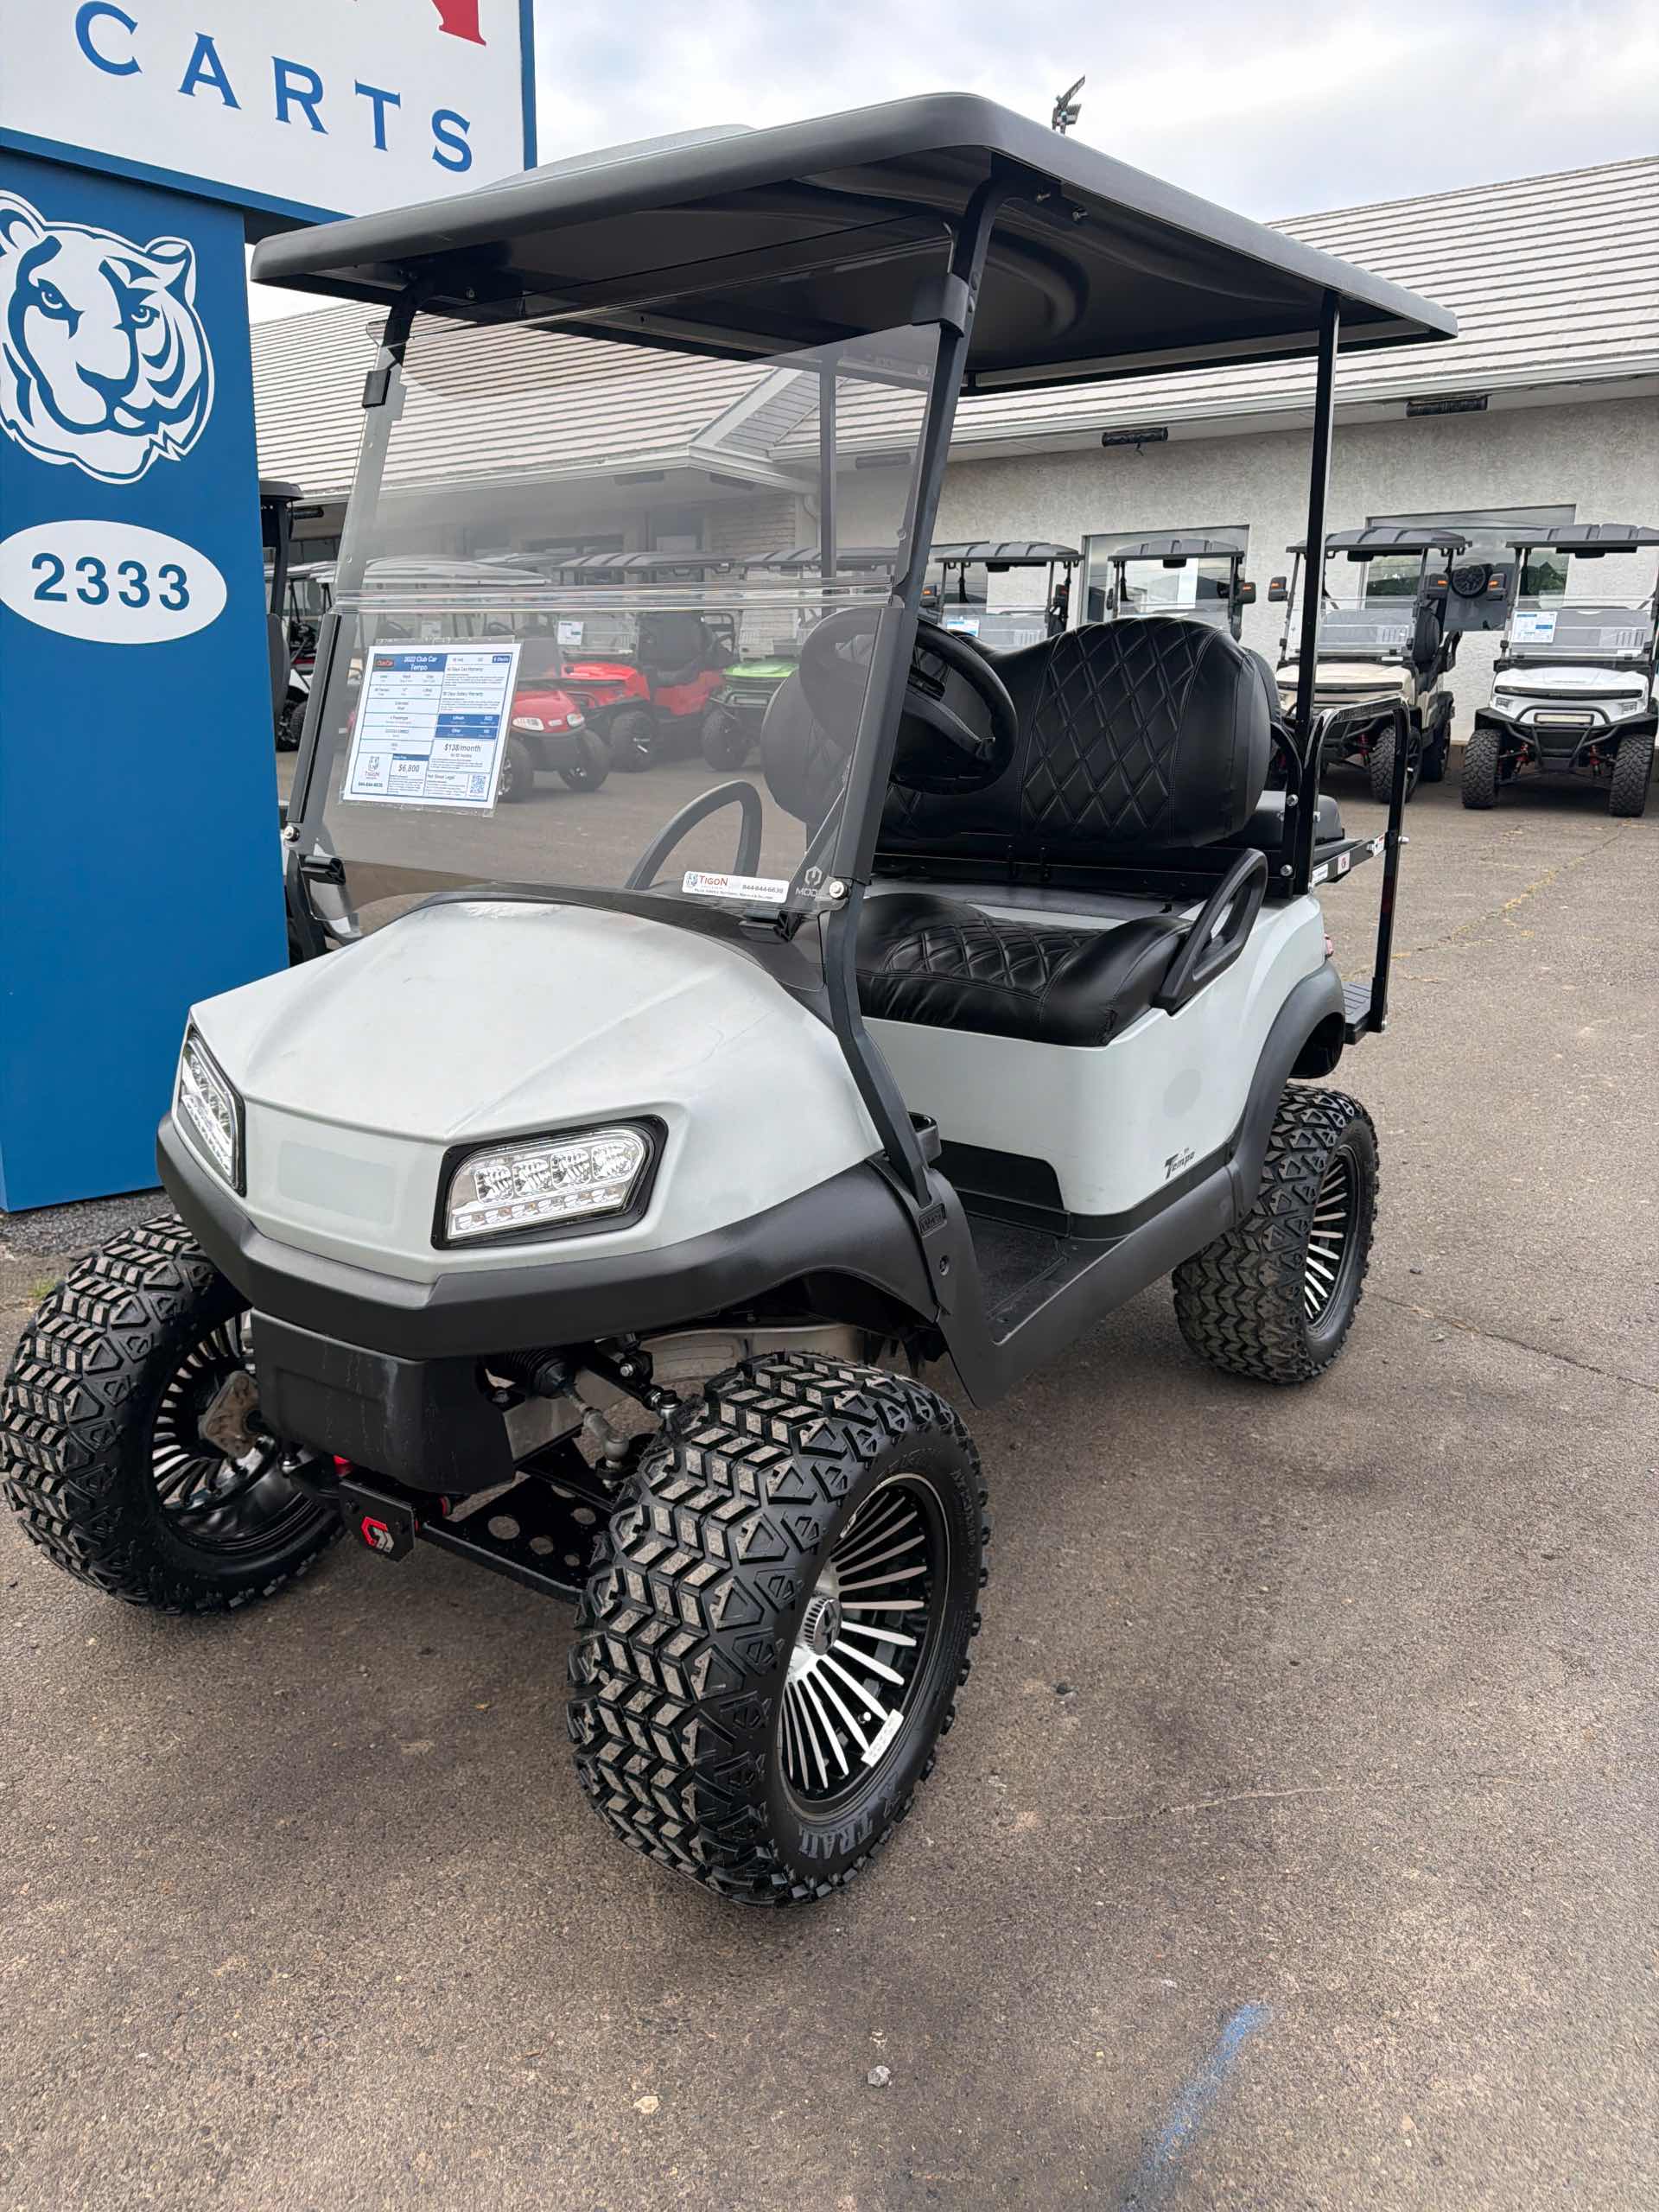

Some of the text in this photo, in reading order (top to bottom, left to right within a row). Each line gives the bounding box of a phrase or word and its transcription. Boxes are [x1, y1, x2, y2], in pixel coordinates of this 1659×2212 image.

[74, 0, 473, 172] CARTS
[31, 552, 190, 612] 2333
[699, 875, 728, 886] TIGON
